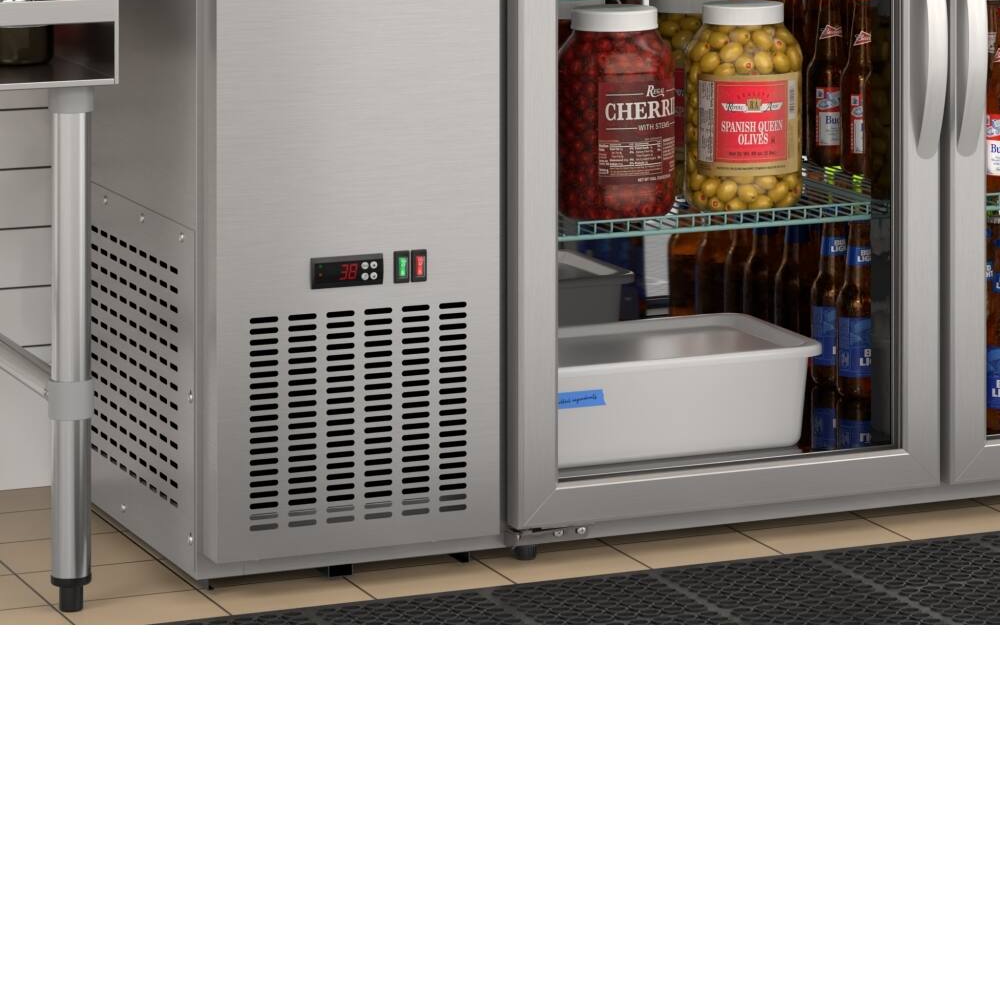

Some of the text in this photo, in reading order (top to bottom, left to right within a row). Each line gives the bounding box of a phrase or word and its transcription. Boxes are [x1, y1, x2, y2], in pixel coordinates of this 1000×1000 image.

[721, 120, 784, 135] SPANISH QUEEN
[738, 133, 769, 146] OLIVES
[340, 263, 358, 280] 38
